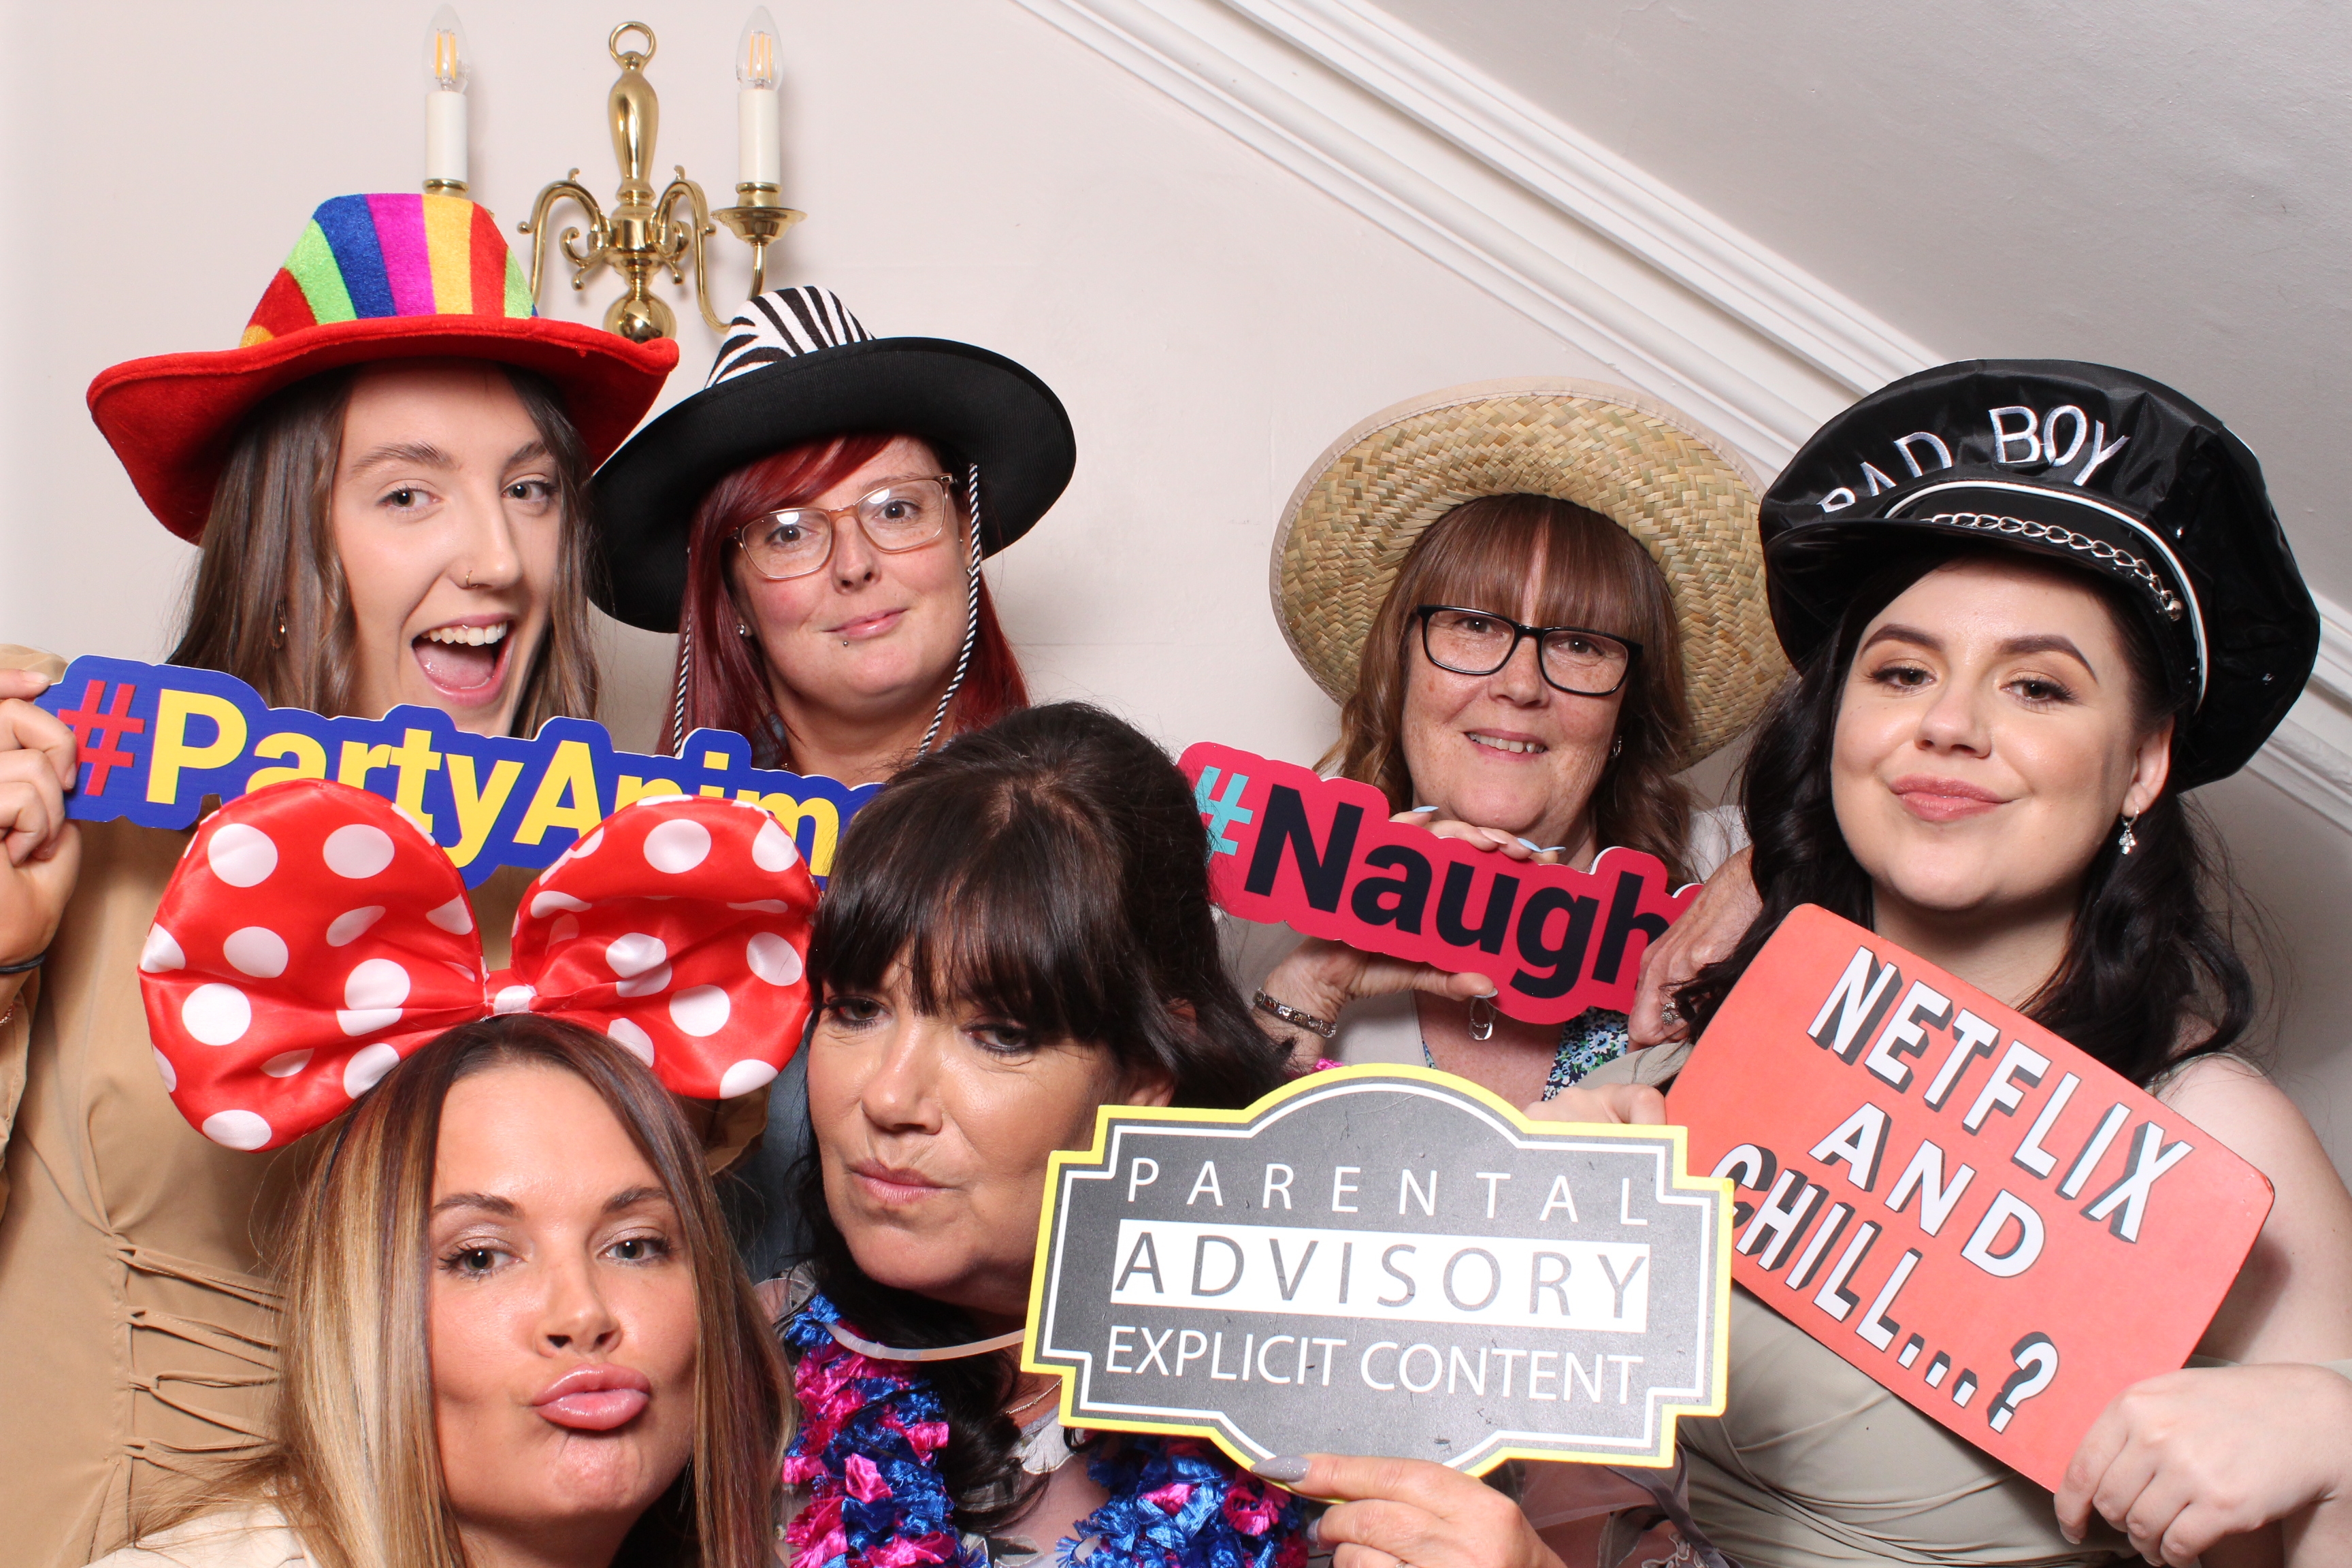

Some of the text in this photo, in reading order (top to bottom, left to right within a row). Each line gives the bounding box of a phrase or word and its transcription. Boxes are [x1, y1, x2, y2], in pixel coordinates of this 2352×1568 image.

[1989, 405, 2130, 486] BOY
[1807, 945, 2195, 1244] NETFLIX
[1127, 1157, 1648, 1225] PARENTAL
[1807, 1100, 2046, 1278] AND
[1114, 1231, 1647, 1320] ADVISORY
[1105, 1324, 1644, 1405] EXPLICIT CONTENT
